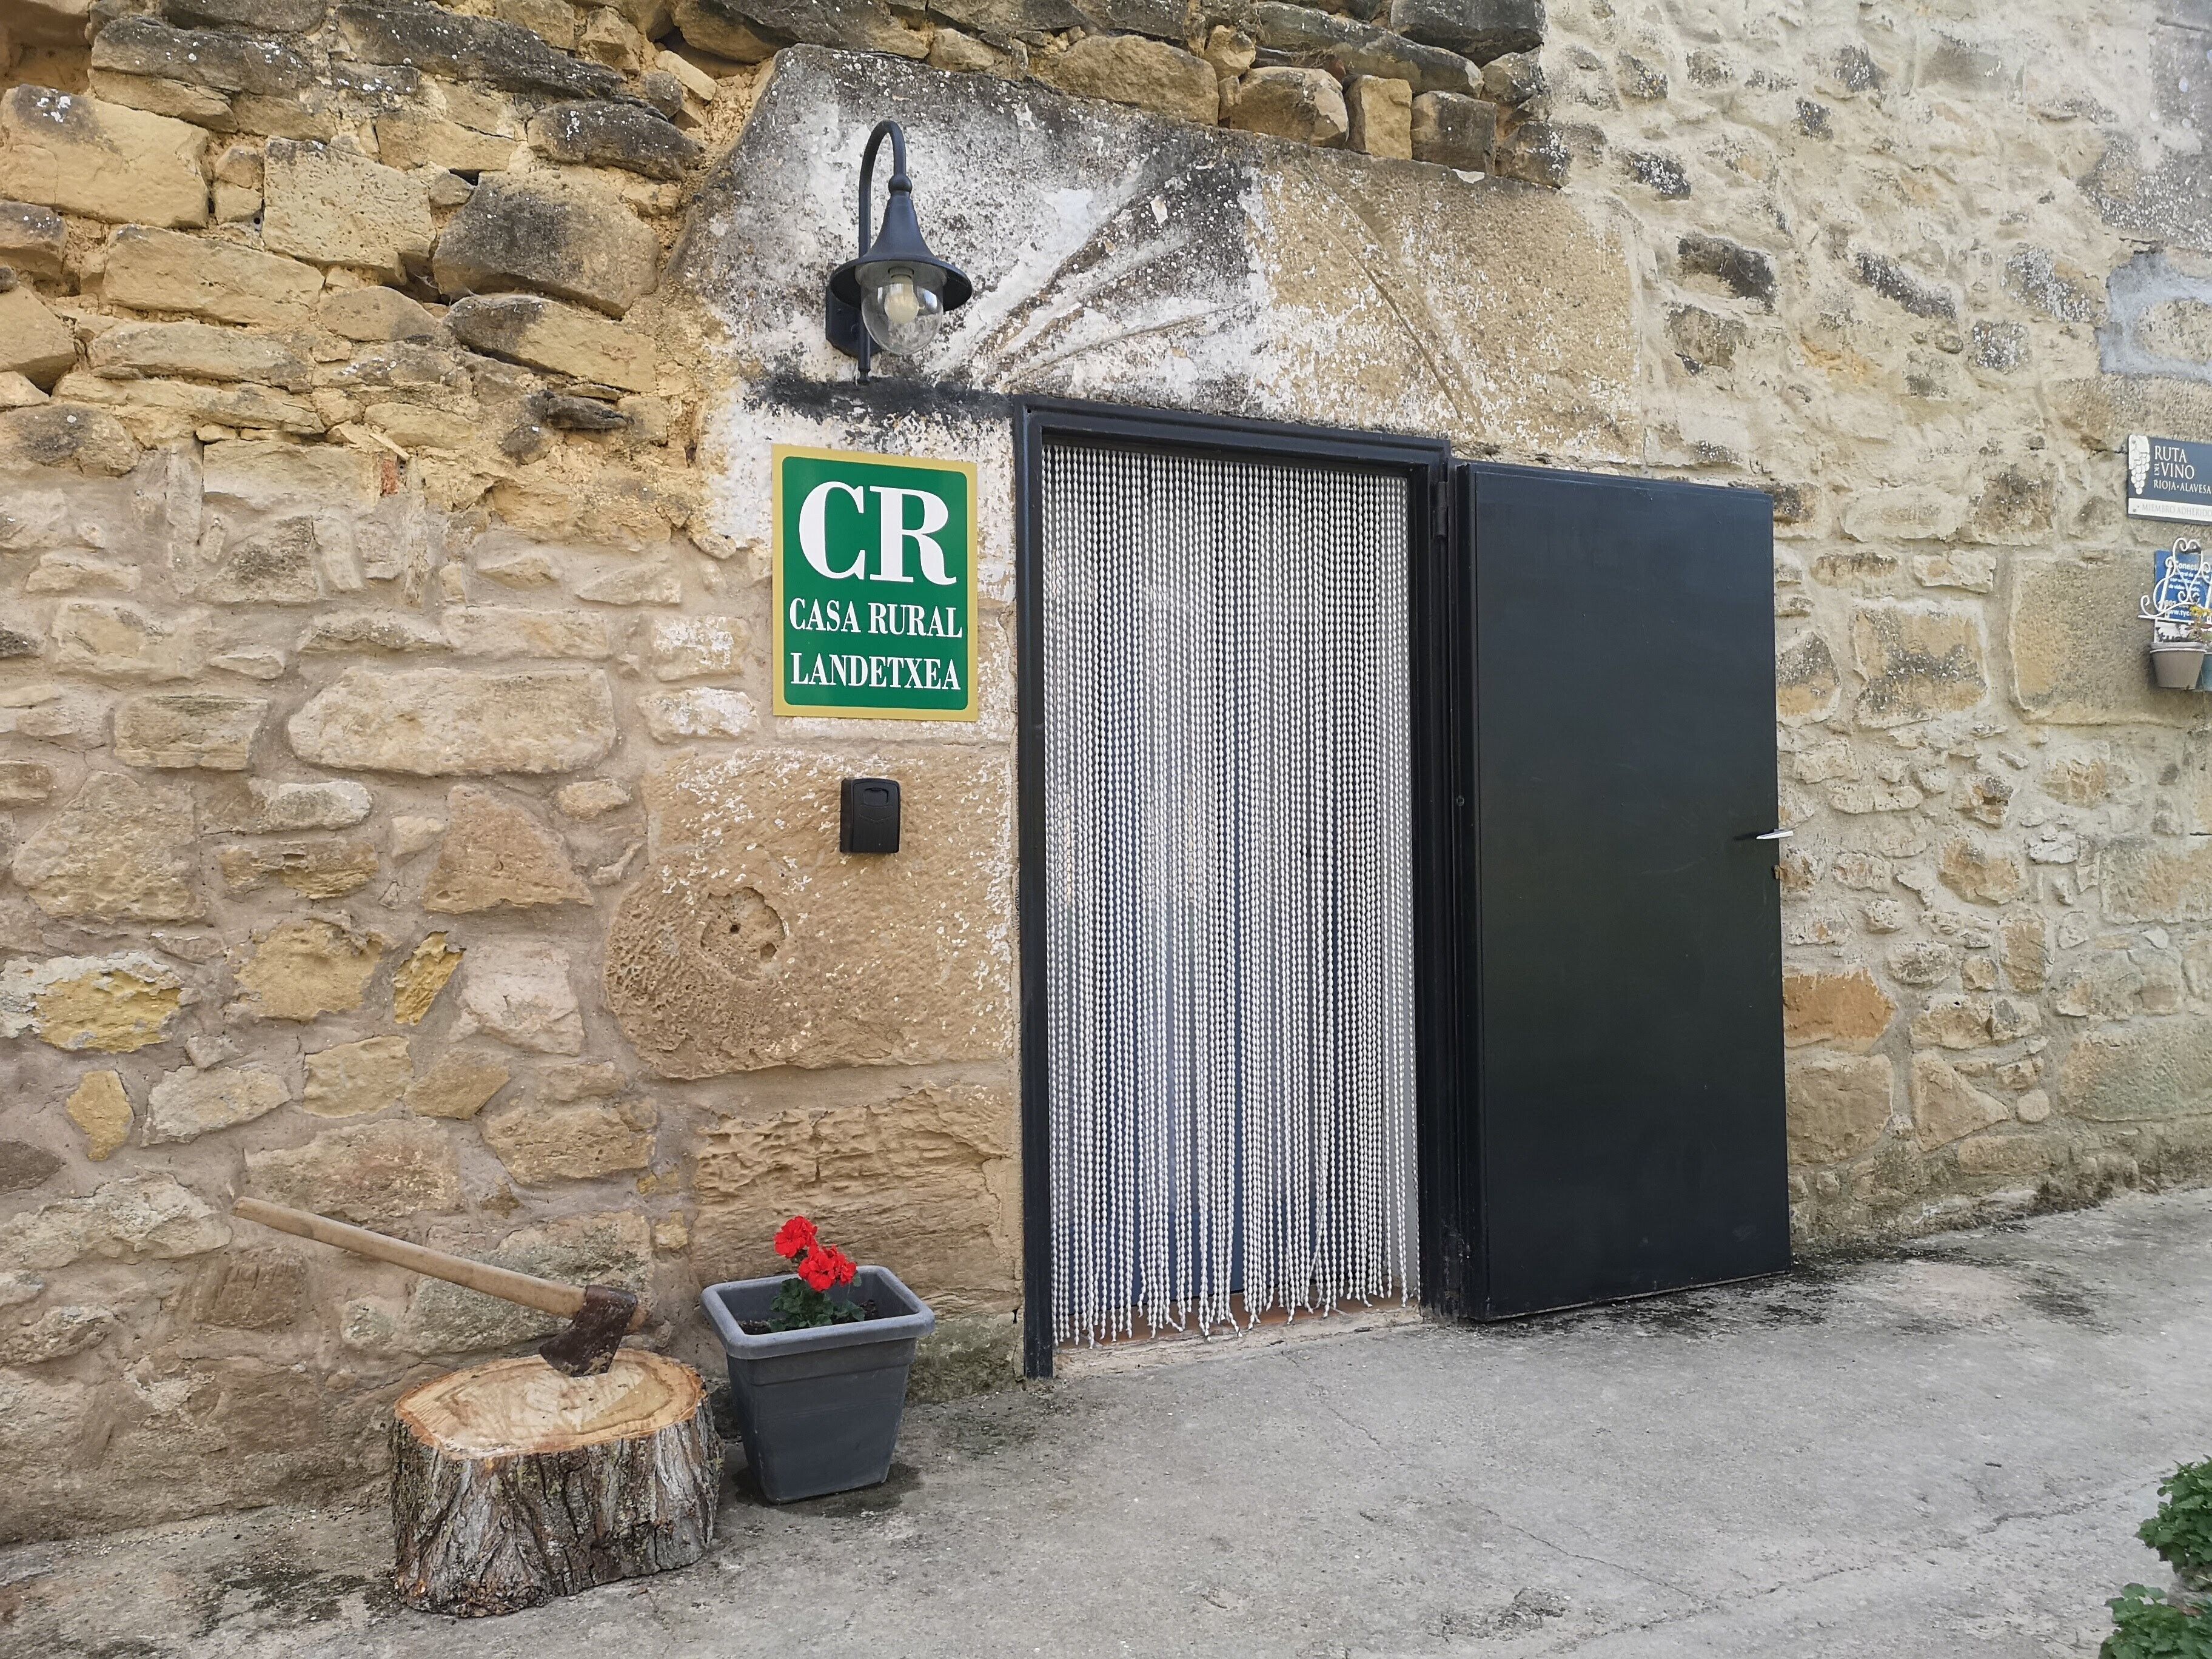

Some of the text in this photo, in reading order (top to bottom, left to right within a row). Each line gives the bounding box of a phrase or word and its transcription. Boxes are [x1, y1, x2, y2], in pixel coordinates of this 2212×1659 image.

[2154, 445, 2187, 463] RUTA
[2160, 462, 2194, 480] VINO
[2142, 504, 2212, 517] MIEMBRO ADHERIDO
[799, 481, 957, 586] CR
[789, 597, 962, 638] CASA RURAL
[790, 652, 961, 690] LANDETXEA
